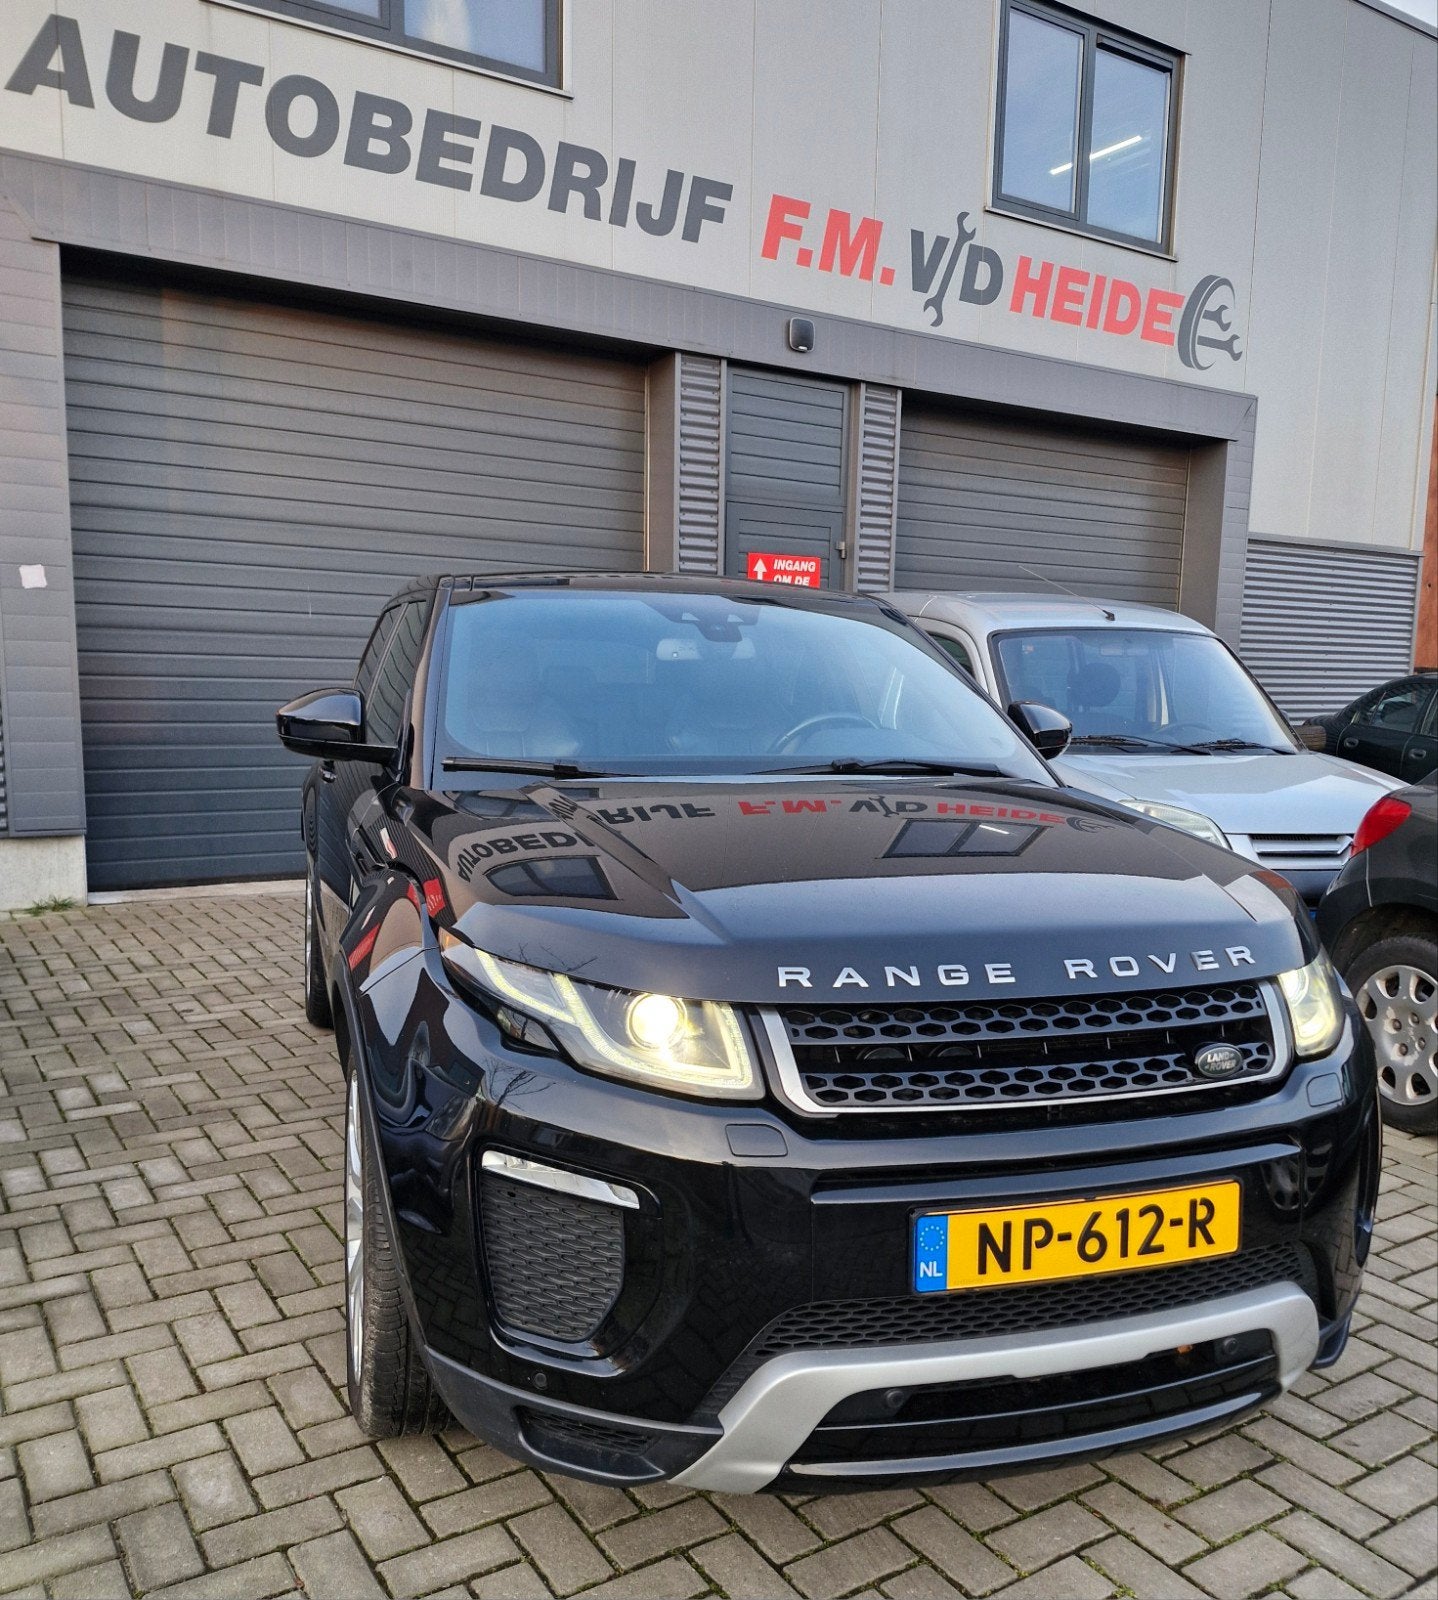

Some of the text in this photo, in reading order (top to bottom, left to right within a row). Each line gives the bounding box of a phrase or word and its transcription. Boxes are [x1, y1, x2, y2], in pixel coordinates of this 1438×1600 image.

[5, 15, 734, 243] AUTOBEDRIJF
[761, 194, 896, 286] F.M.
[1009, 255, 1186, 347] HEIDE
[773, 559, 816, 573] INGANG
[773, 575, 811, 587] OM DE
[777, 946, 1257, 988] RANGE ROVER
[1207, 1051, 1230, 1063] LAND
[977, 1196, 1216, 1276] NP-612-R
[919, 1260, 943, 1279] NL
